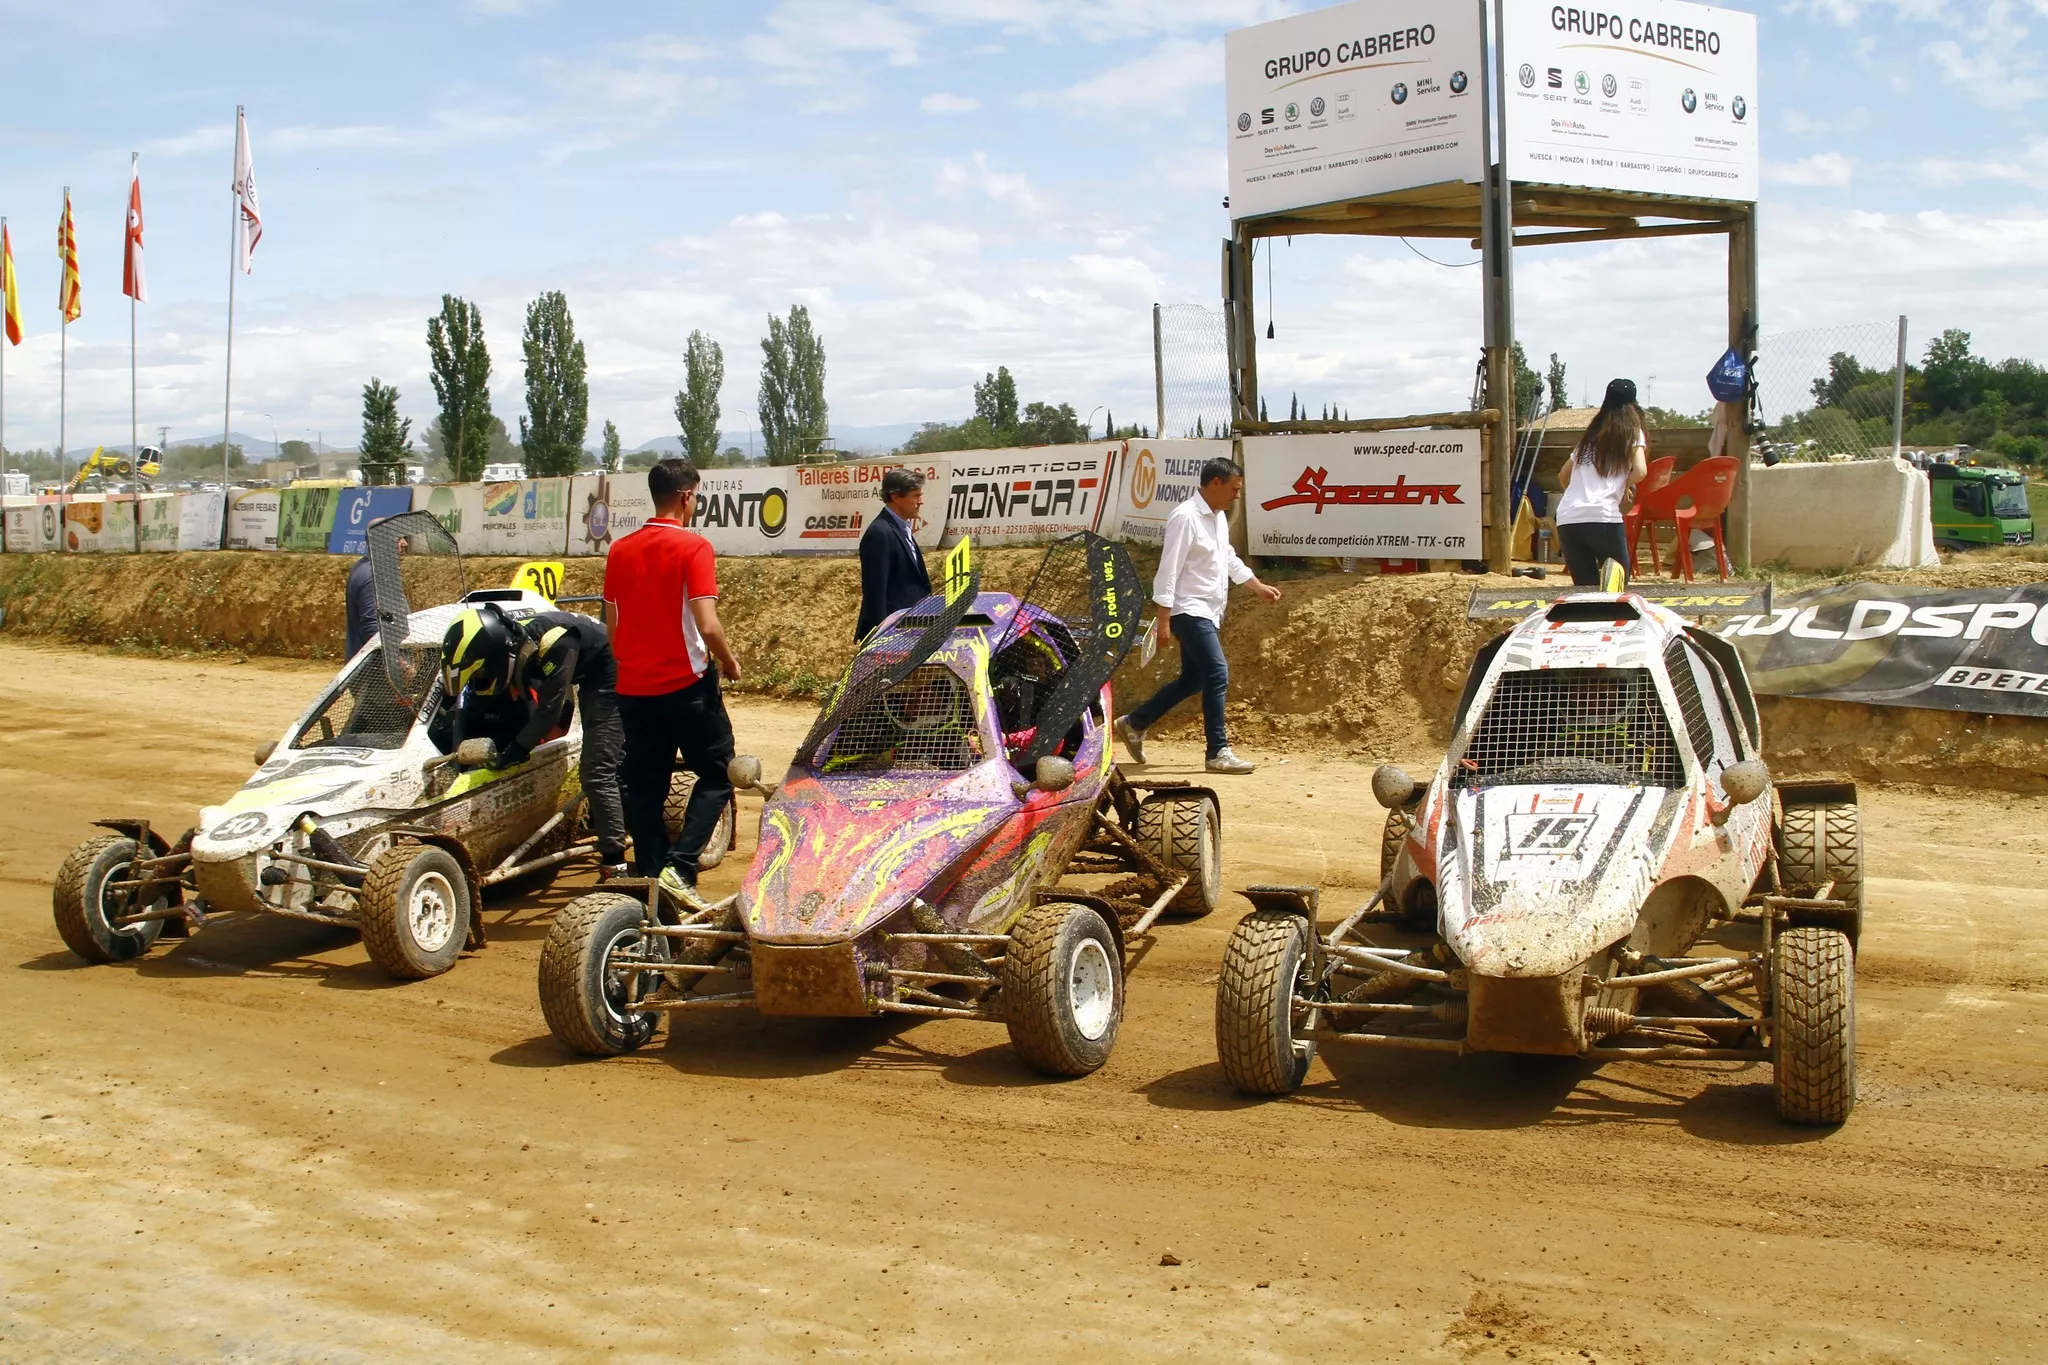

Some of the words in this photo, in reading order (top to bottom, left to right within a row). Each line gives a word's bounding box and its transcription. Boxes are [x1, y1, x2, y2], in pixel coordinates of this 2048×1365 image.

[1551, 6, 1623, 40] GRUPO
[1629, 18, 1721, 55] CABRERO
[1264, 47, 1331, 80] GRUPO
[1336, 24, 1436, 63] CABRERO
[1416, 78, 1433, 87] MINI
[1416, 85, 1441, 96] Service
[1543, 93, 1567, 103] SEAT
[1704, 92, 1718, 101] MINI
[1629, 105, 1647, 113] Service
[1704, 101, 1725, 111] Service
[1437, 113, 1458, 121] Selection
[1257, 127, 1279, 136] SEAT
[1246, 175, 1266, 183] HUESCA
[1272, 170, 1295, 179] MONZÓN
[1300, 165, 1322, 174] BINÉFAR
[1329, 159, 1358, 168] BARBASTRO
[1365, 152, 1393, 162] LOGROÑO
[1399, 141, 1459, 157] GRUPOCABRERO.COM
[1529, 153, 1552, 161] HUESCA
[1560, 155, 1584, 164] MONZÓN
[1591, 158, 1614, 167] BINÉFAR
[1620, 162, 1650, 170] BARBASTRO
[1657, 166, 1681, 174] LOGROÑO
[1688, 169, 1739, 179] GRUPOCABRERO.COM
[1354, 442, 1463, 457] www.speed-car.com
[796, 467, 850, 486] Talleres
[697, 480, 743, 491] INTURAS
[821, 488, 869, 502] Maquinaria
[947, 478, 1098, 519] MONFORT
[256, 503, 277, 512] FEBAS
[682, 487, 788, 536] PANTO
[612, 512, 637, 527] León
[804, 515, 848, 530] CASE
[945, 527, 959, 536] Telf.
[961, 527, 972, 535] 974
[973, 526, 982, 535] 42
[982, 526, 991, 534] 73
[991, 526, 1000, 535] 41
[1006, 525, 1027, 534] 22510
[1028, 523, 1060, 533] BINACED
[1120, 521, 1158, 538] Maquinaria
[1262, 533, 1304, 545] Vehículos
[1305, 534, 1317, 545] de
[1318, 534, 1374, 548] competición
[1376, 536, 1409, 547] XTREM
[1417, 536, 1436, 547] TTX
[1444, 536, 1465, 548] GTR
[527, 567, 557, 601] 30
[1517, 818, 1588, 849] 15
